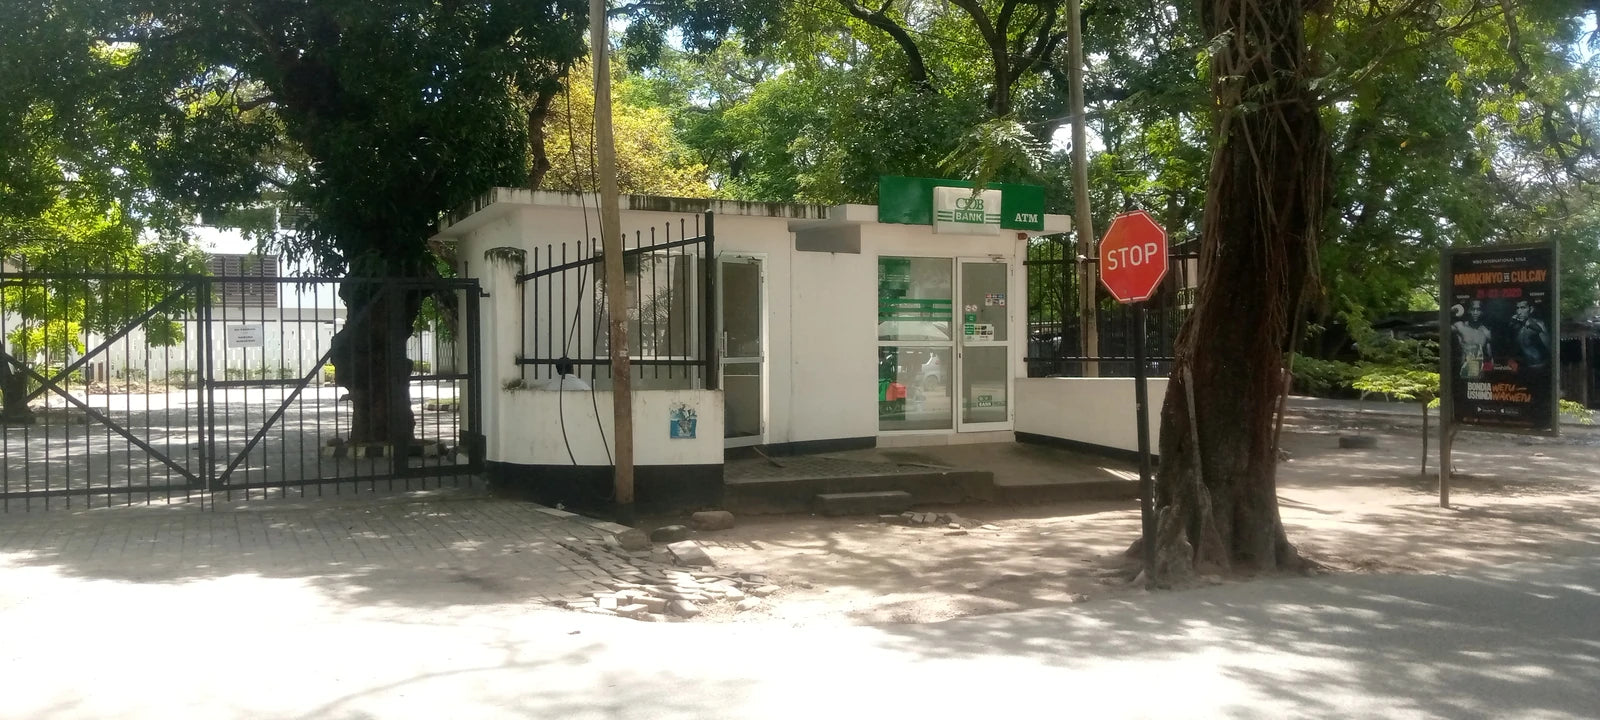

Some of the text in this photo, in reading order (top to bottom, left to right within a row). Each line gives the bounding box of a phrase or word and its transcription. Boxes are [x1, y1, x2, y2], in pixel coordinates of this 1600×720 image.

[956, 211, 983, 222] BANK
[1015, 213, 1038, 223] ATM
[1107, 242, 1158, 271] STOP
[1454, 272, 1503, 286] MWAKINYO
[1511, 270, 1546, 282] CULCAY
